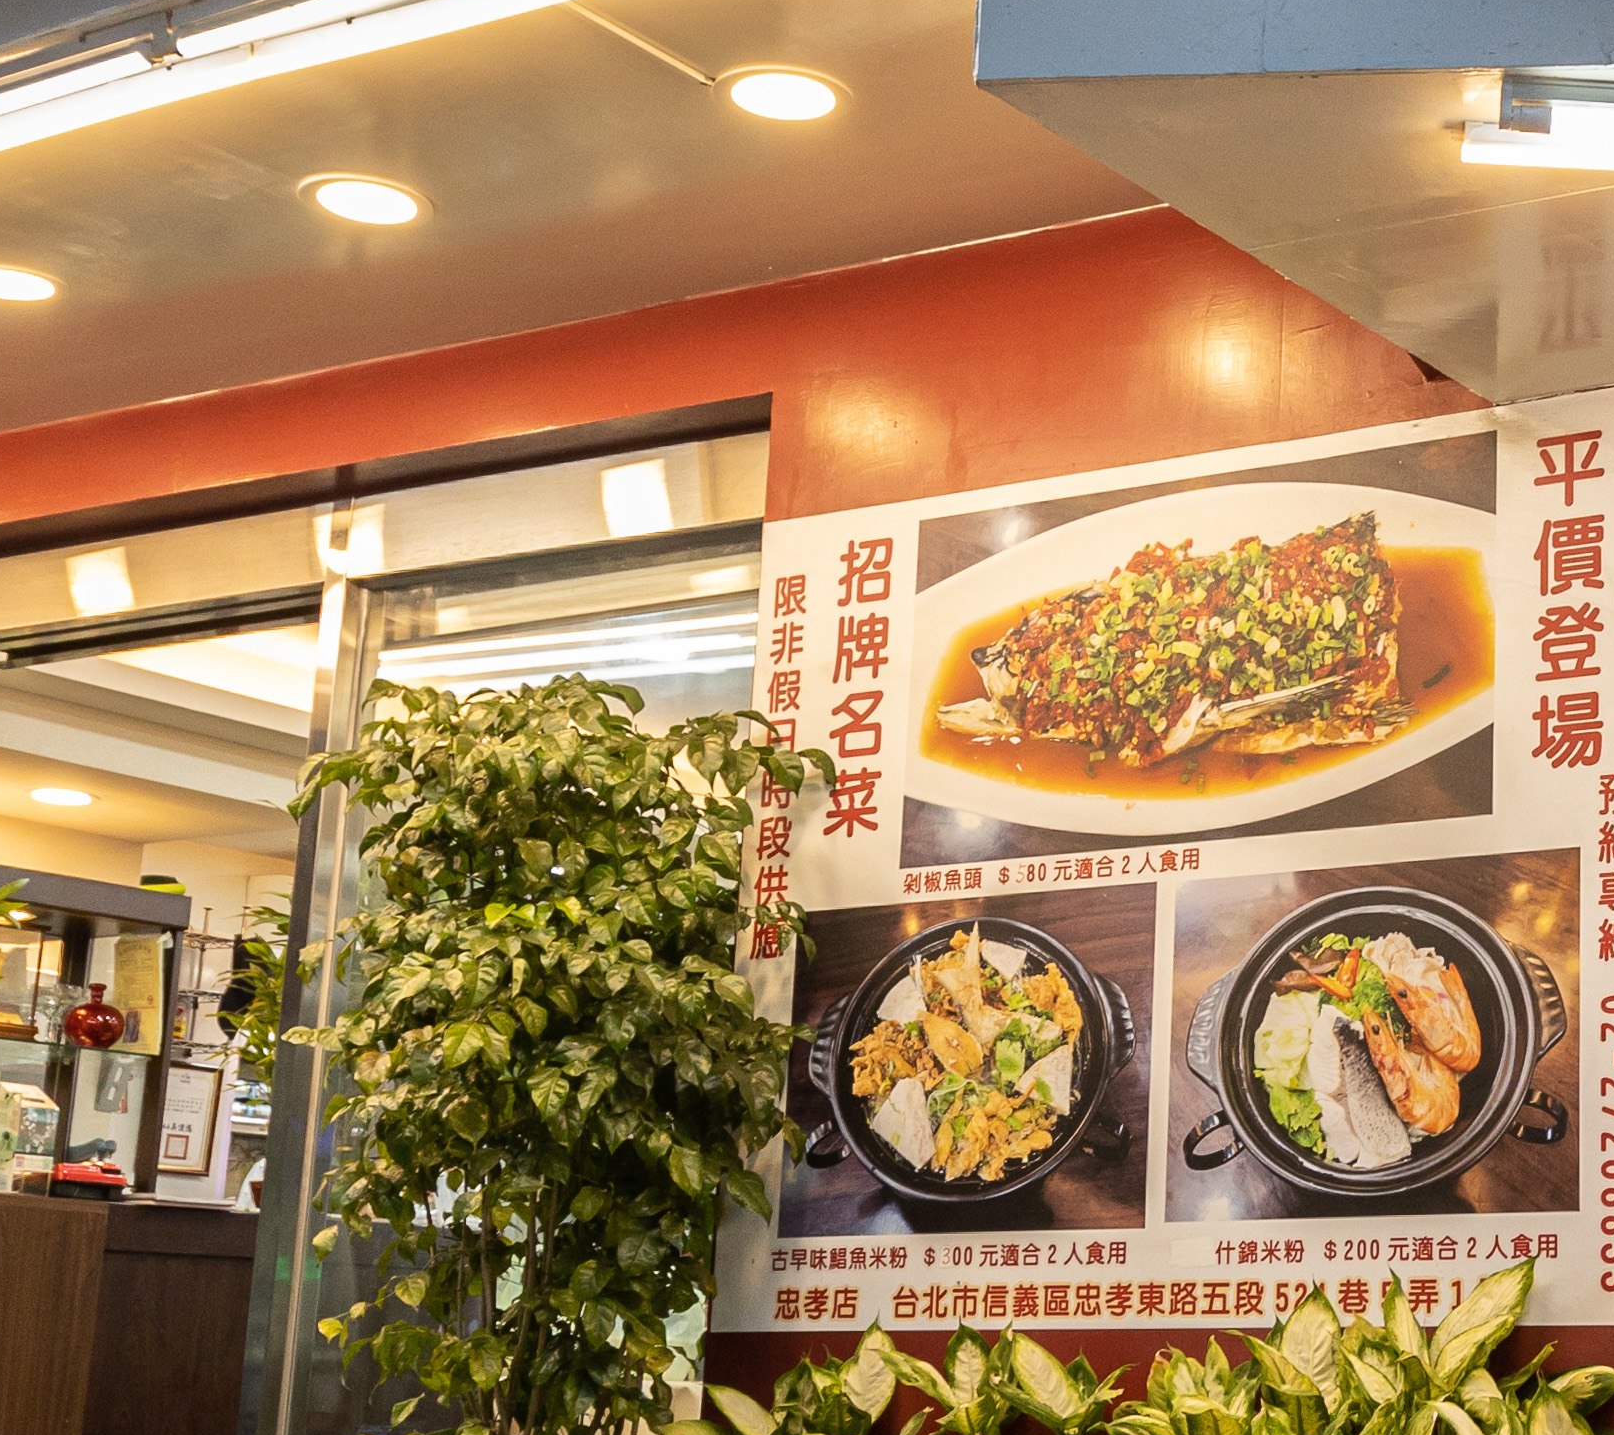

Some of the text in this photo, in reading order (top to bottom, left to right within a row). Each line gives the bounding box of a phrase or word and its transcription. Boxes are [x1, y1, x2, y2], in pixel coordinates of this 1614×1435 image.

[1531, 429, 1605, 769] 平價登場
[822, 537, 893, 838] 招牌名菜
[902, 866, 983, 895] 剁椒魚頭
[770, 1246, 908, 1272] 古早味鯧魚米粉
[1215, 1238, 1305, 1265] 什錦米粉
[774, 1286, 859, 1320] 忠孝店
